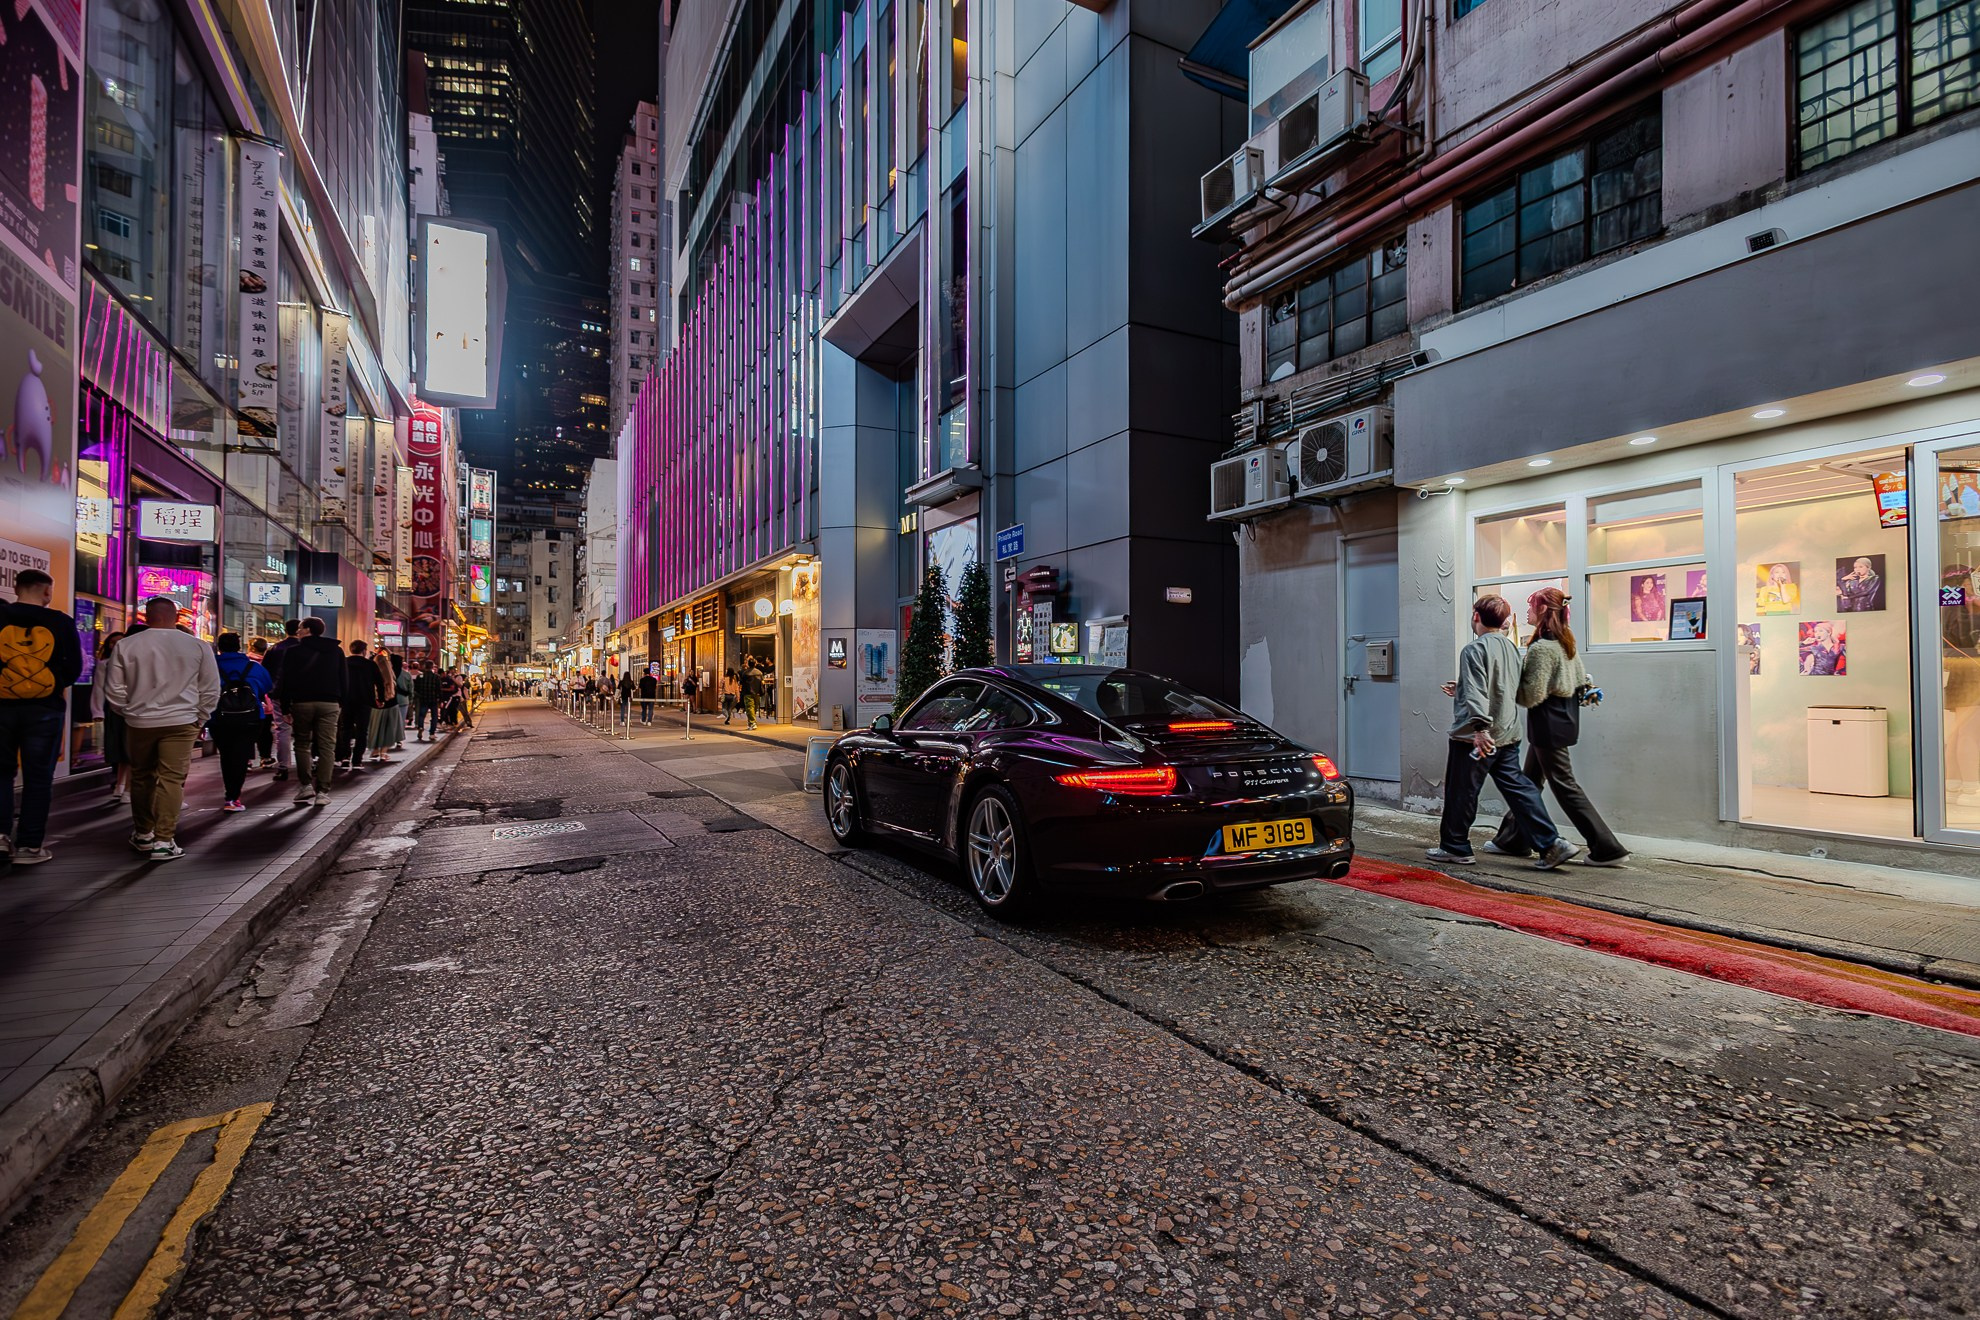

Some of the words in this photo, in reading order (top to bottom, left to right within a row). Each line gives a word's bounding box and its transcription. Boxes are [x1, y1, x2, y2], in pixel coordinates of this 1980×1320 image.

[0, 264, 66, 350] SMILE
[242, 380, 273, 390] V-point
[1351, 427, 1367, 436] GREE
[413, 461, 435, 549] 永光中心
[153, 507, 202, 528] 稻埕
[998, 532, 1012, 542] Private
[1012, 527, 1023, 538] Road
[1002, 540, 1019, 554] 私家路
[8, 549, 18, 564] TO
[20, 553, 31, 567] SEE
[830, 640, 843, 653] M
[1213, 767, 1304, 778] PORSCHE
[1231, 826, 1258, 848] MF
[1263, 821, 1306, 845] 3189
